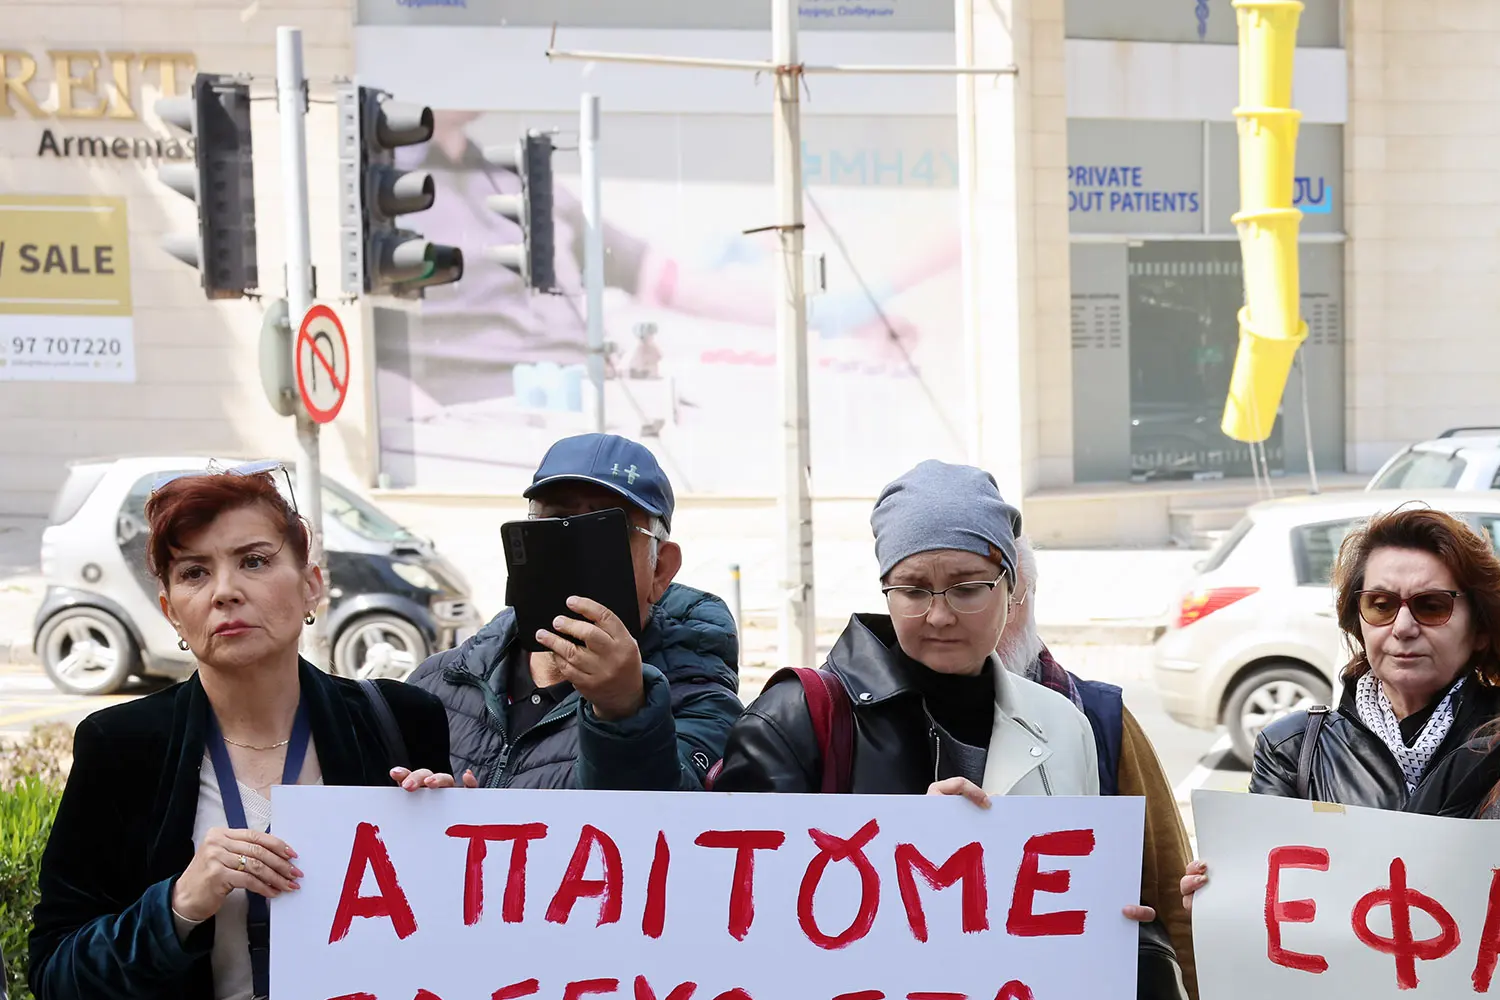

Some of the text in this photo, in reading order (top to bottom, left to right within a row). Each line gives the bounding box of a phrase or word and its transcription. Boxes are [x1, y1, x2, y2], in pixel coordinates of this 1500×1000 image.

[1110, 192, 1199, 213] PATIENTS
[19, 243, 115, 275] SALE
[12, 336, 121, 356] 97 707220
